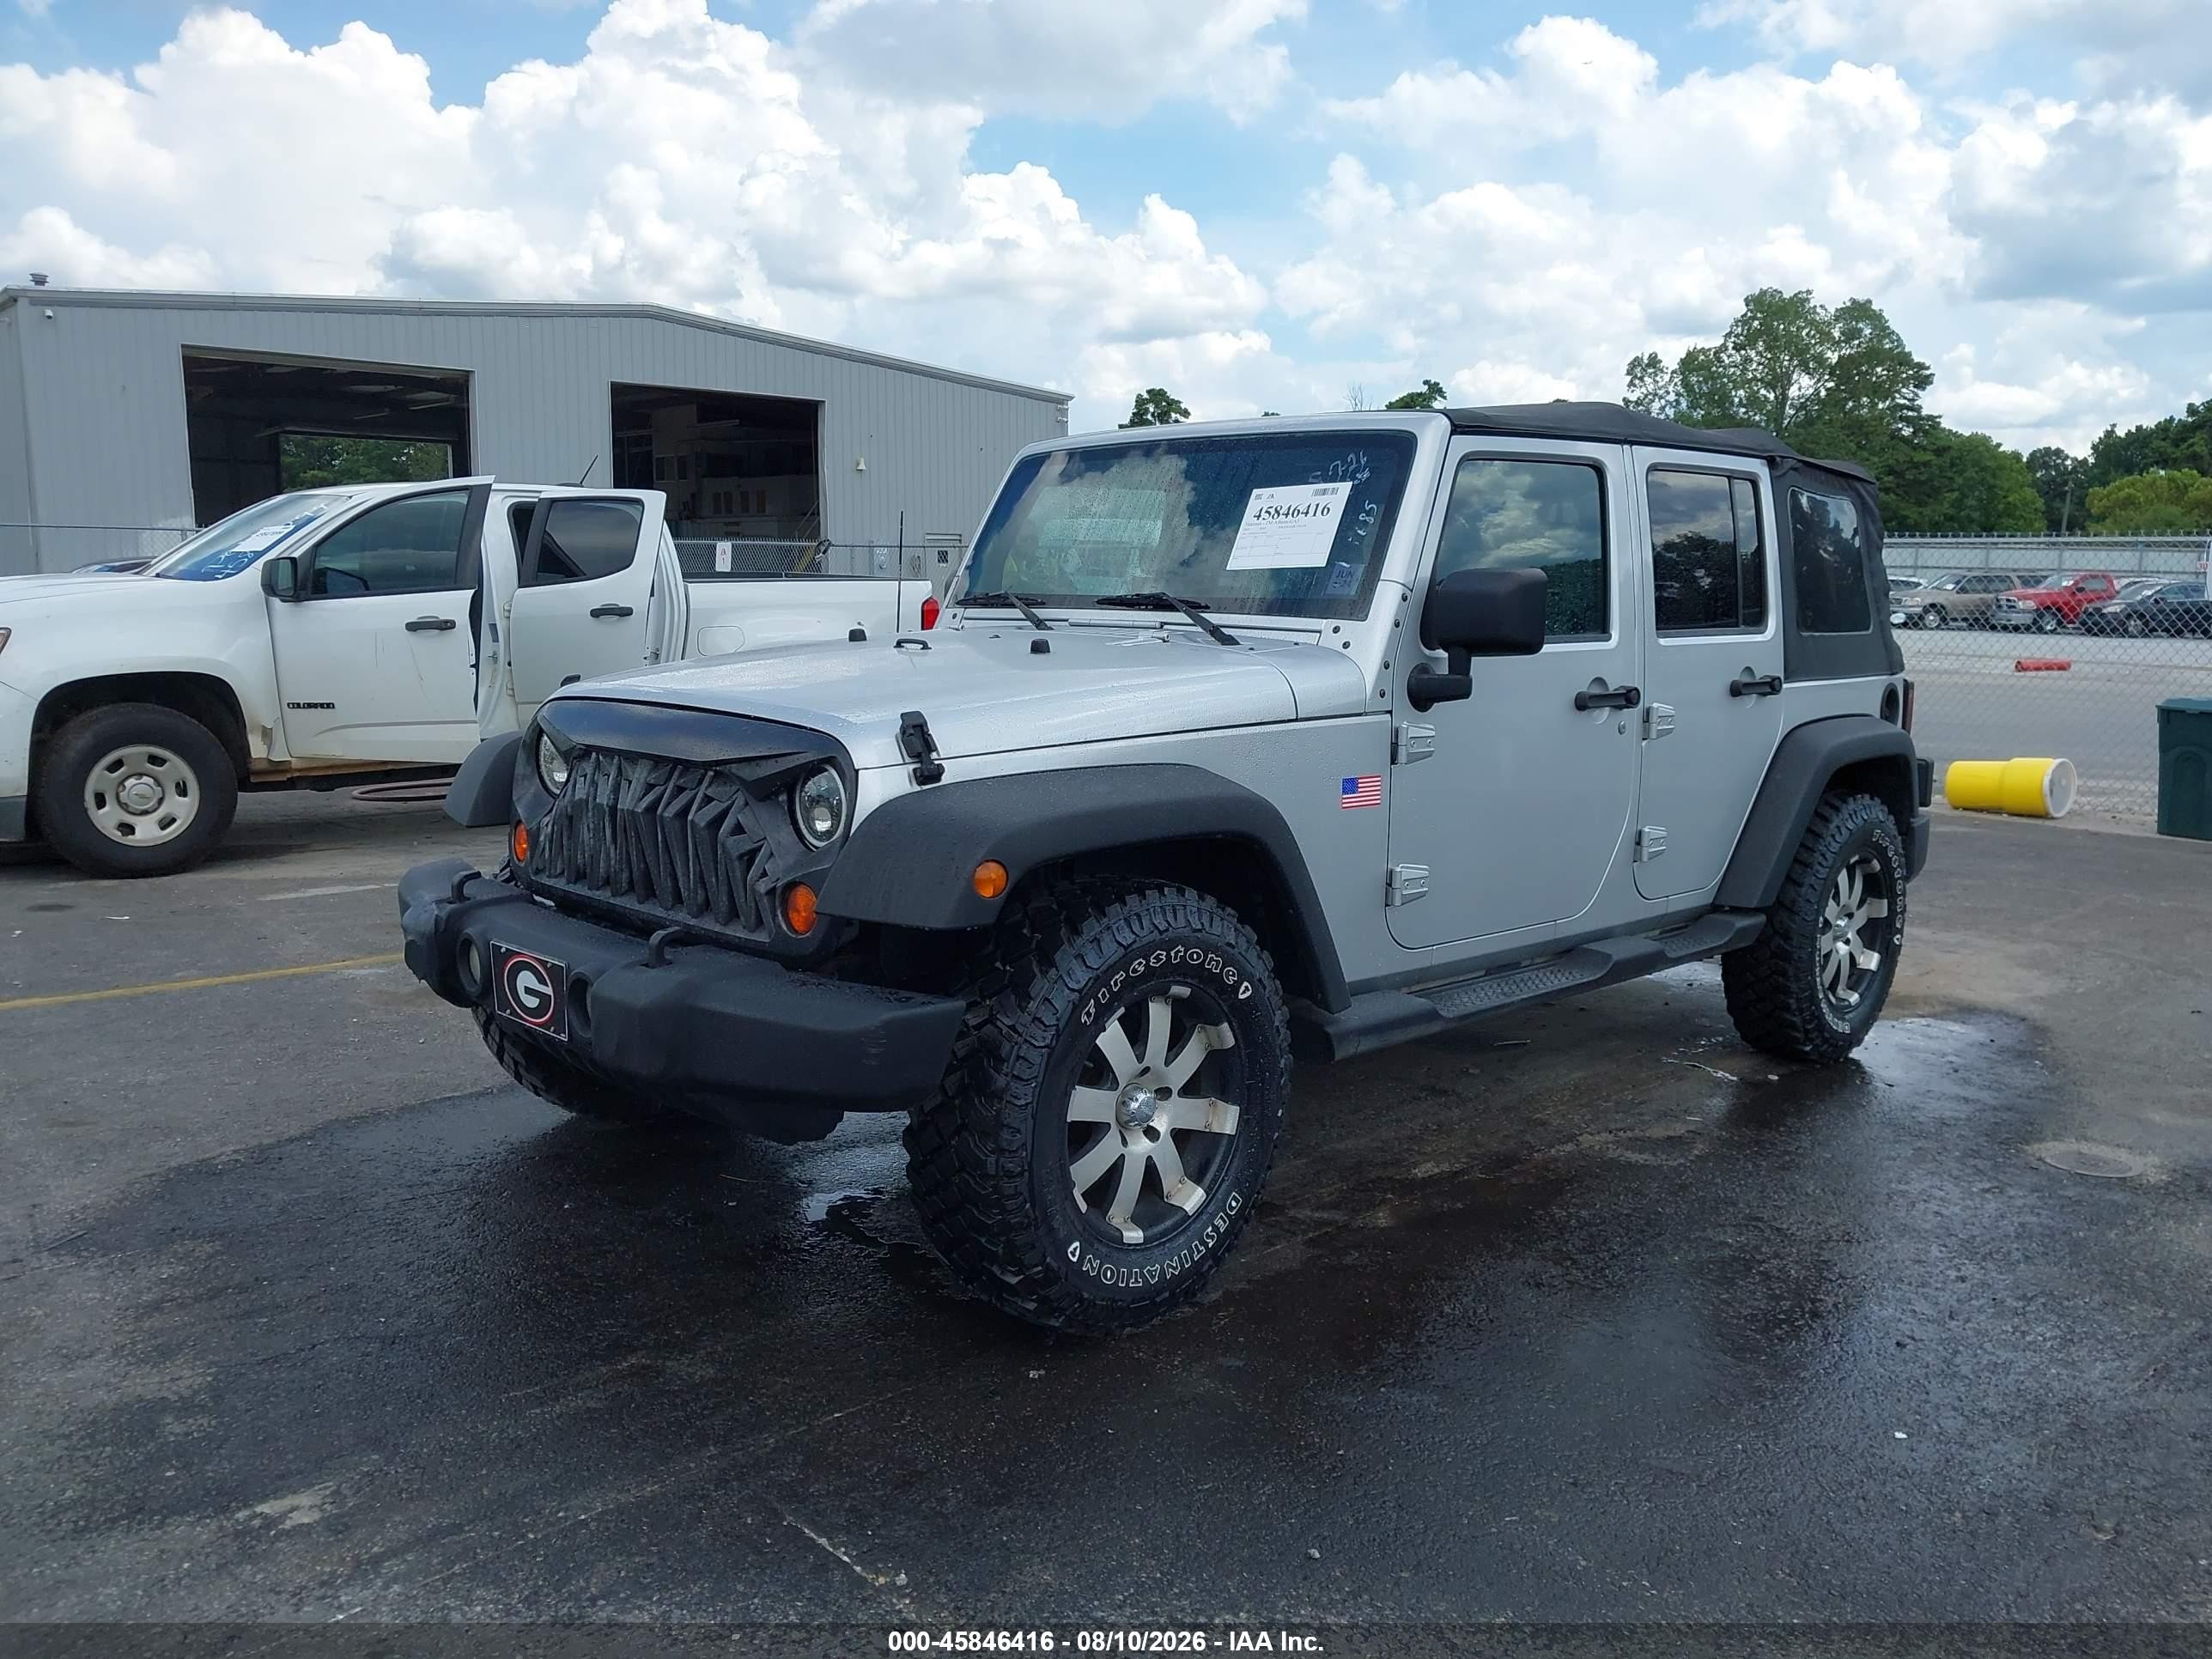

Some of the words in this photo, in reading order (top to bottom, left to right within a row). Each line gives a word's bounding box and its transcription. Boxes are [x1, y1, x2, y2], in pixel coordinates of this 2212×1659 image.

[1254, 501, 1332, 521] 45846416
[516, 969, 554, 1009] G
[1080, 945, 1238, 1025] Firestone
[1084, 1193, 1243, 1288] DESTINATION
